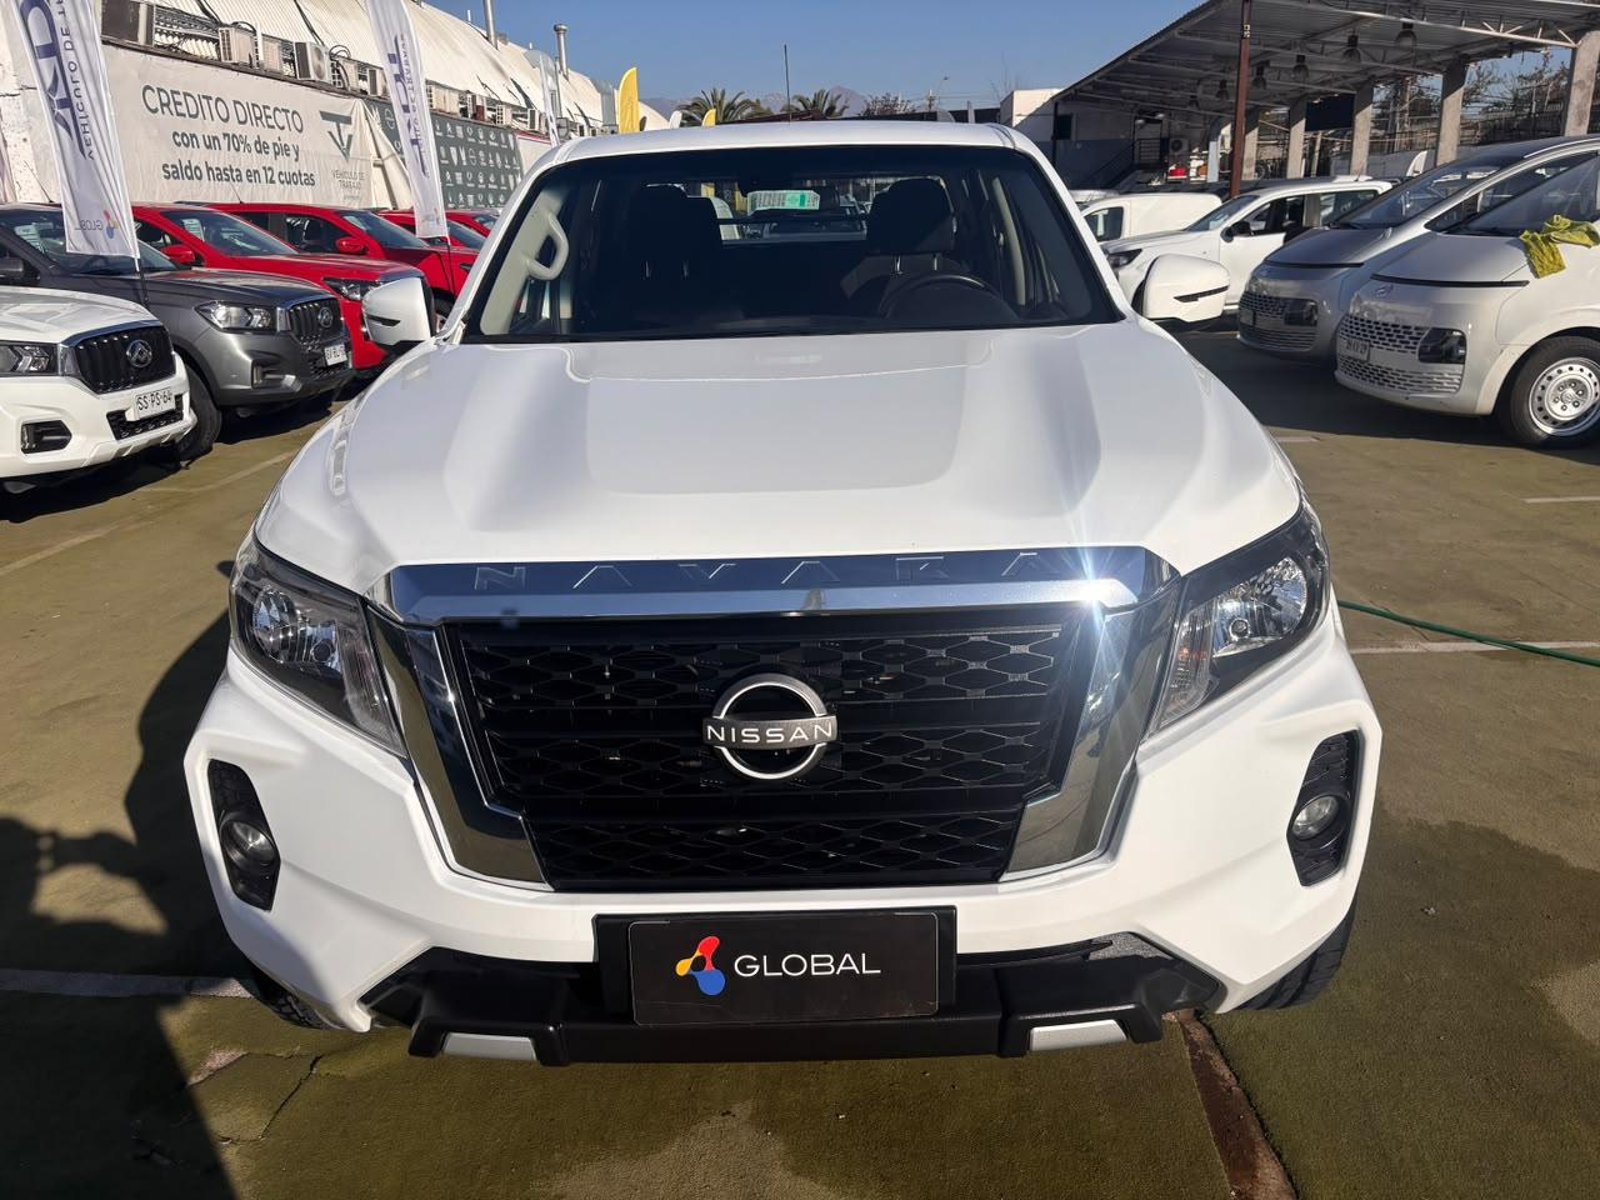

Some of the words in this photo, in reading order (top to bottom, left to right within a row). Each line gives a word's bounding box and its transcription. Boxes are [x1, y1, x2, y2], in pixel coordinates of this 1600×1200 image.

[142, 84, 230, 123] CREDITO
[232, 99, 304, 133] DIRECTO
[172, 130, 200, 149] con
[203, 134, 222, 151] un
[222, 132, 252, 153] 70%
[254, 135, 270, 155] de
[273, 136, 291, 160] pie
[292, 144, 300, 163] y
[162, 159, 203, 181] saldo
[205, 161, 243, 183] hasta
[246, 169, 261, 184] en
[262, 166, 276, 184] 12
[278, 169, 316, 187] cuotas
[474, 551, 1060, 591] NAVARA
[706, 723, 832, 744] NISSAN
[734, 952, 881, 977] GLOBAL
